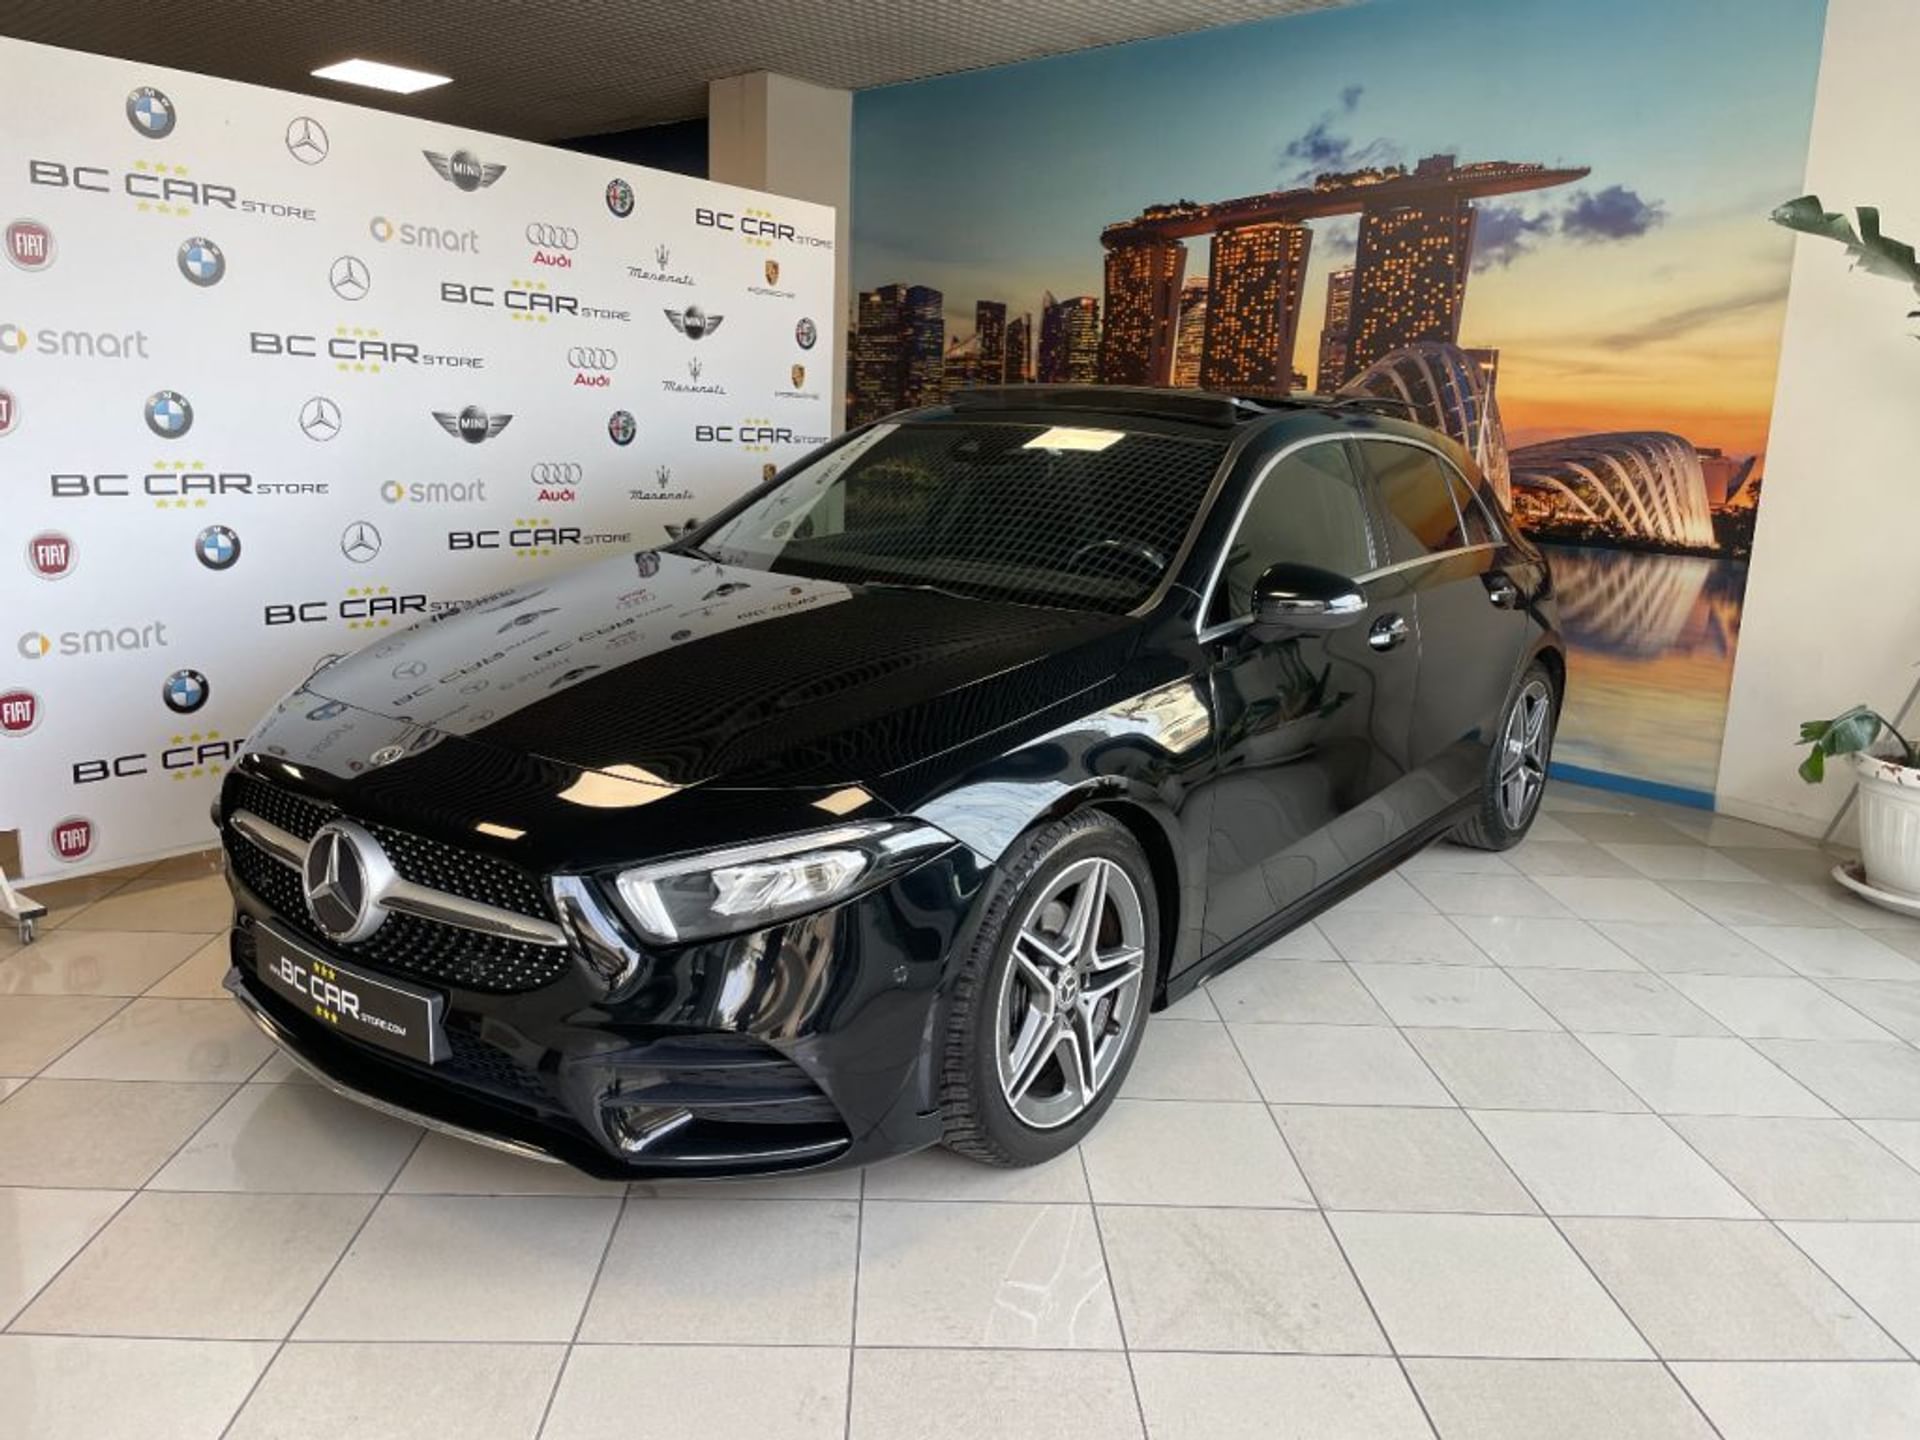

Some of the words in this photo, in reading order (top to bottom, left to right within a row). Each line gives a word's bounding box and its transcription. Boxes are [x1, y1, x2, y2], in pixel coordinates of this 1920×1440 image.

[453, 161, 483, 179] MINI
[29, 160, 110, 194] BC
[125, 173, 238, 210] CAR
[241, 200, 317, 222] STORE
[695, 208, 734, 232] BC
[740, 217, 795, 243] CAR
[15, 232, 45, 259] FIAT
[400, 223, 480, 256] smart
[533, 251, 573, 270] Audi
[441, 282, 496, 308] BC
[504, 291, 580, 317] CAR
[581, 306, 632, 322] STORE
[37, 328, 150, 360] smart
[250, 331, 317, 357] BC
[328, 338, 421, 364] CAR
[422, 353, 486, 370] STORE
[574, 372, 612, 389] Audi
[460, 416, 488, 432] MINI
[695, 426, 733, 444] BC
[739, 427, 793, 445] CAR
[50, 473, 129, 498] BC
[144, 473, 254, 496] CAR
[257, 482, 330, 496] STORE
[409, 479, 486, 504] smart
[537, 487, 576, 503] Audi
[448, 530, 501, 551] BC
[509, 527, 583, 548] CAR
[583, 532, 632, 546] STORE
[37, 542, 68, 568] FIAT
[264, 602, 328, 626] BC
[339, 594, 427, 620] CAR
[59, 621, 168, 656] smart
[2, 700, 32, 723] FIAT
[73, 760, 148, 784] BC
[59, 828, 88, 849] FIAT
[281, 956, 308, 994] BC
[311, 974, 360, 1020] CAR
